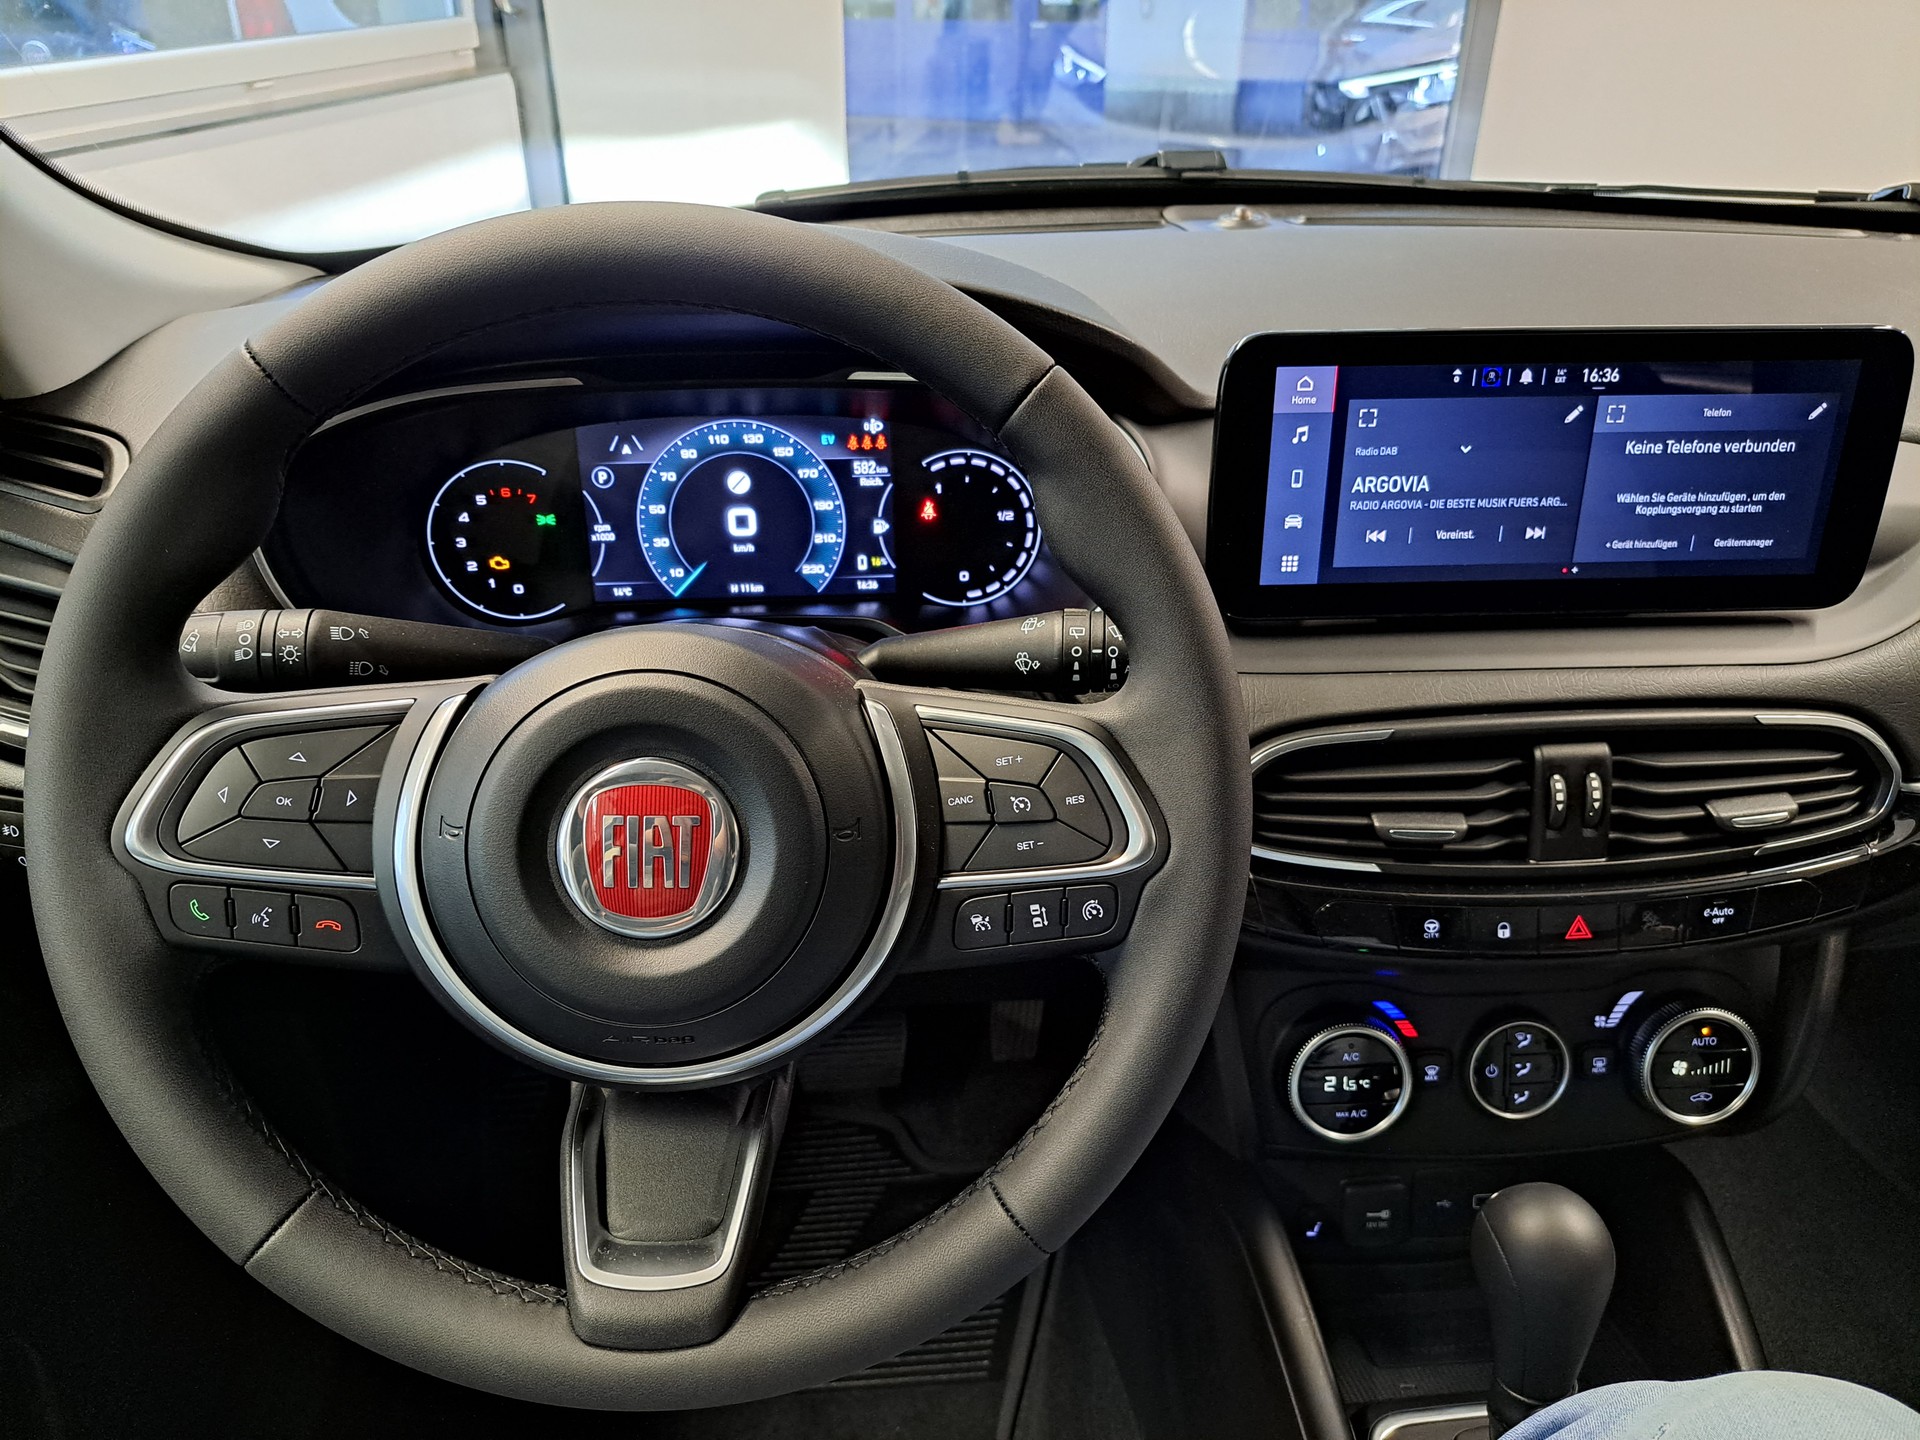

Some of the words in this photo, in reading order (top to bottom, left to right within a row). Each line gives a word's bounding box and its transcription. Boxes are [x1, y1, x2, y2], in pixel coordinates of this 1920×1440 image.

[1582, 368, 1620, 383] 16:36
[1291, 396, 1317, 405] Home
[1703, 408, 1732, 417] Telefon
[708, 435, 730, 444] 110
[742, 434, 764, 444] 130
[821, 434, 835, 446] EV
[773, 447, 794, 457] 150
[1355, 447, 1379, 456] Radio
[1380, 446, 1398, 456] DAB
[1625, 440, 1663, 454] Keine
[1666, 439, 1722, 454] Telefone
[1724, 439, 1796, 453] verbunden
[680, 449, 697, 459] 90
[597, 471, 608, 484] P
[659, 472, 677, 481] 70
[797, 469, 818, 478] 170
[935, 483, 942, 494] 1
[1351, 475, 1430, 494] ARGOVIA
[500, 487, 511, 498] 6
[1617, 492, 1650, 503] Wählen
[1651, 492, 1666, 502] Sie
[1667, 492, 1696, 502] Geräte
[1752, 494, 1767, 502] um
[1768, 491, 1786, 501] den
[475, 494, 487, 506] 5
[526, 494, 537, 504] 7
[1350, 500, 1380, 510] RADIO
[1381, 500, 1423, 510] ARGOVIA
[1429, 499, 1446, 509] DIE
[1447, 499, 1476, 509] BESTE
[1477, 498, 1507, 508] MUSIK
[1508, 498, 1539, 508] FUERS
[648, 505, 666, 514] 50
[814, 501, 834, 511] 190
[1635, 504, 1718, 516] Kopplungsvorgang
[1718, 505, 1730, 514] zu
[1730, 504, 1762, 514] starten
[458, 512, 470, 523] 4
[727, 507, 757, 537] 0
[997, 511, 1014, 522] 1/2
[593, 524, 611, 532] rpm
[591, 533, 615, 541] x1000
[814, 534, 836, 544] 210
[1436, 529, 1475, 540] Voreinst.
[456, 537, 467, 548] 3
[653, 538, 670, 547] 30
[733, 543, 755, 553] km/h
[1612, 539, 1633, 549] Gerät
[1633, 539, 1678, 550] hinzufügen
[1714, 537, 1773, 548] Gerätemanager
[466, 561, 478, 572] 2
[669, 568, 684, 578] 10
[959, 571, 970, 582] 0
[488, 578, 496, 589] 1
[513, 584, 525, 594] 0
[995, 756, 1014, 766] SET
[275, 795, 293, 807] OK
[948, 795, 974, 806] CANC
[1065, 794, 1085, 805] RES
[1017, 839, 1036, 850] SET
[602, 814, 701, 889] FIAT
[1703, 907, 1734, 917] e-Auto
[1691, 1037, 1717, 1046] AUTO
[1342, 1053, 1360, 1061] A/C
[1350, 1109, 1368, 1117] A/C
